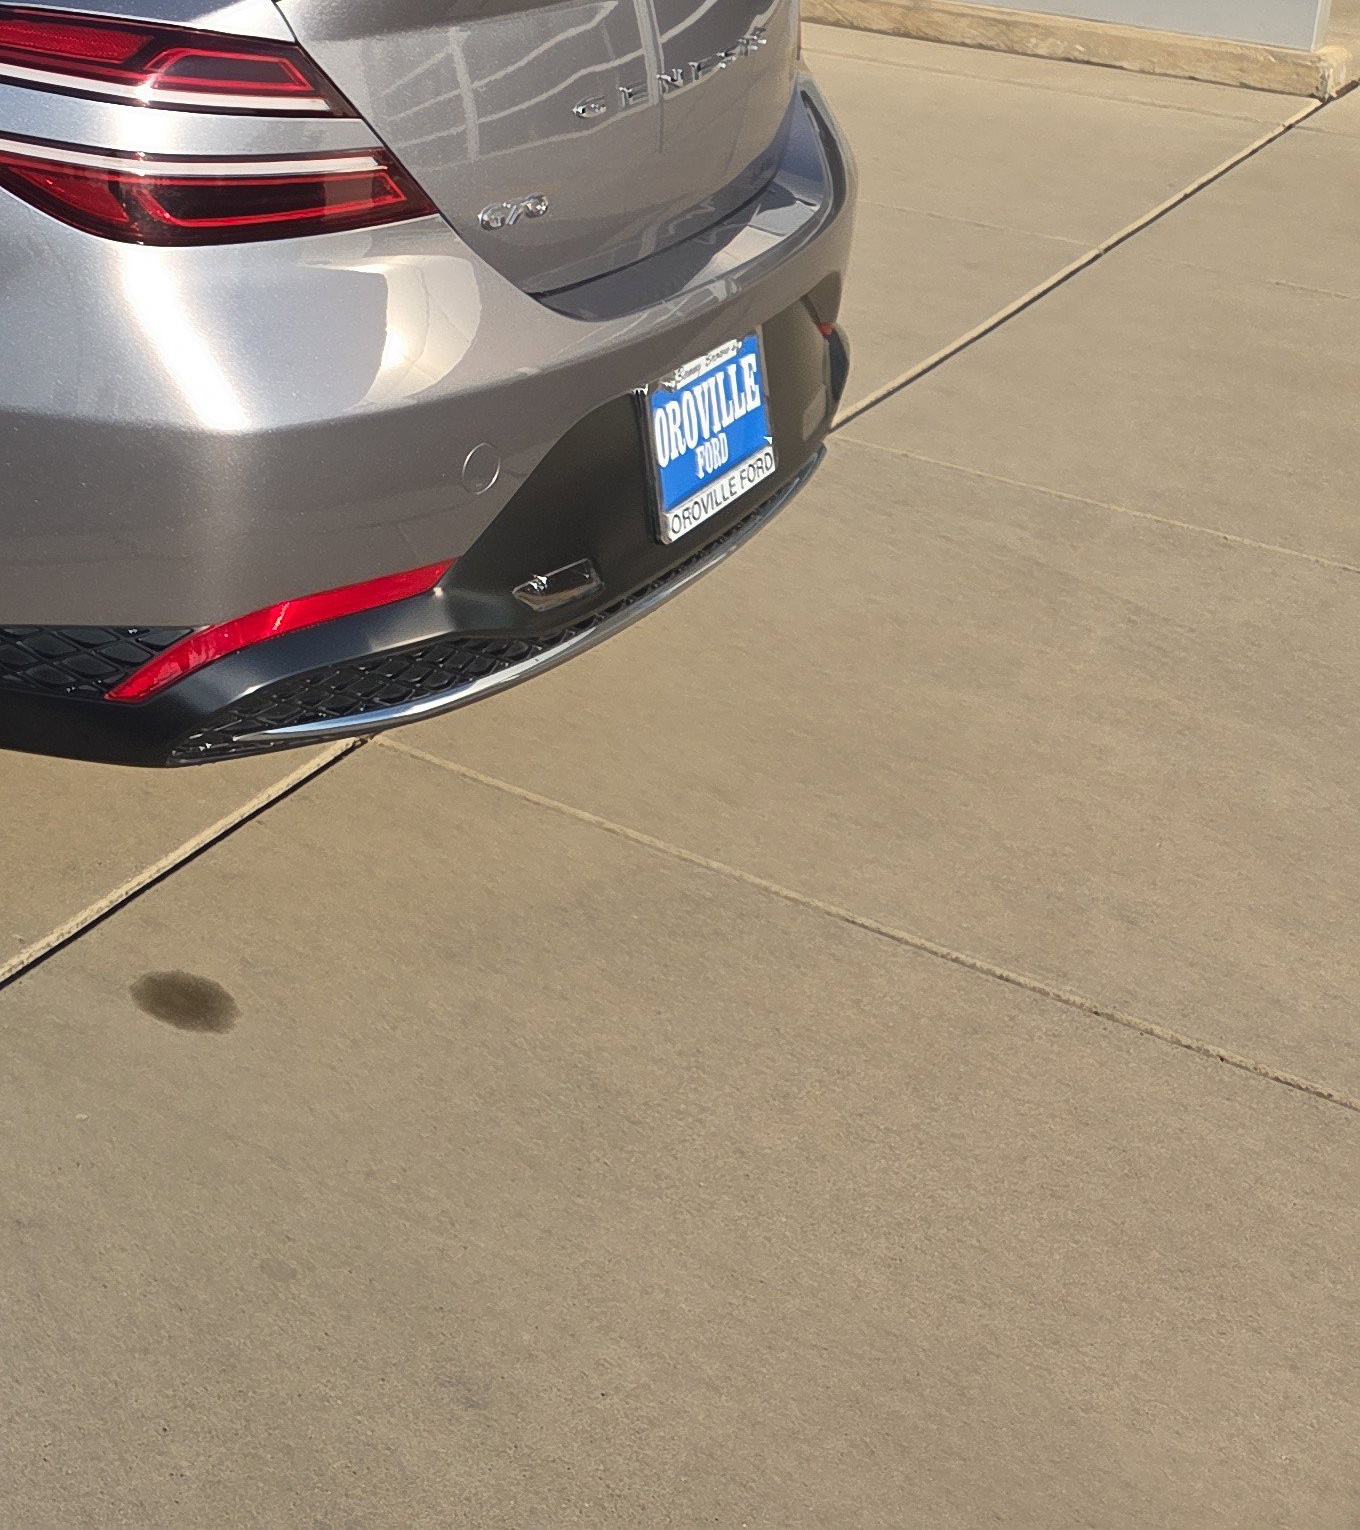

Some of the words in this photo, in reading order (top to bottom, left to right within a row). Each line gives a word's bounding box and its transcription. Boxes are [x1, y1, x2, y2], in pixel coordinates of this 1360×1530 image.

[654, 354, 761, 468] OROVILLE
[671, 476, 736, 534] OROVILLE
[739, 451, 773, 491] FORD
[694, 433, 729, 479] FORD
